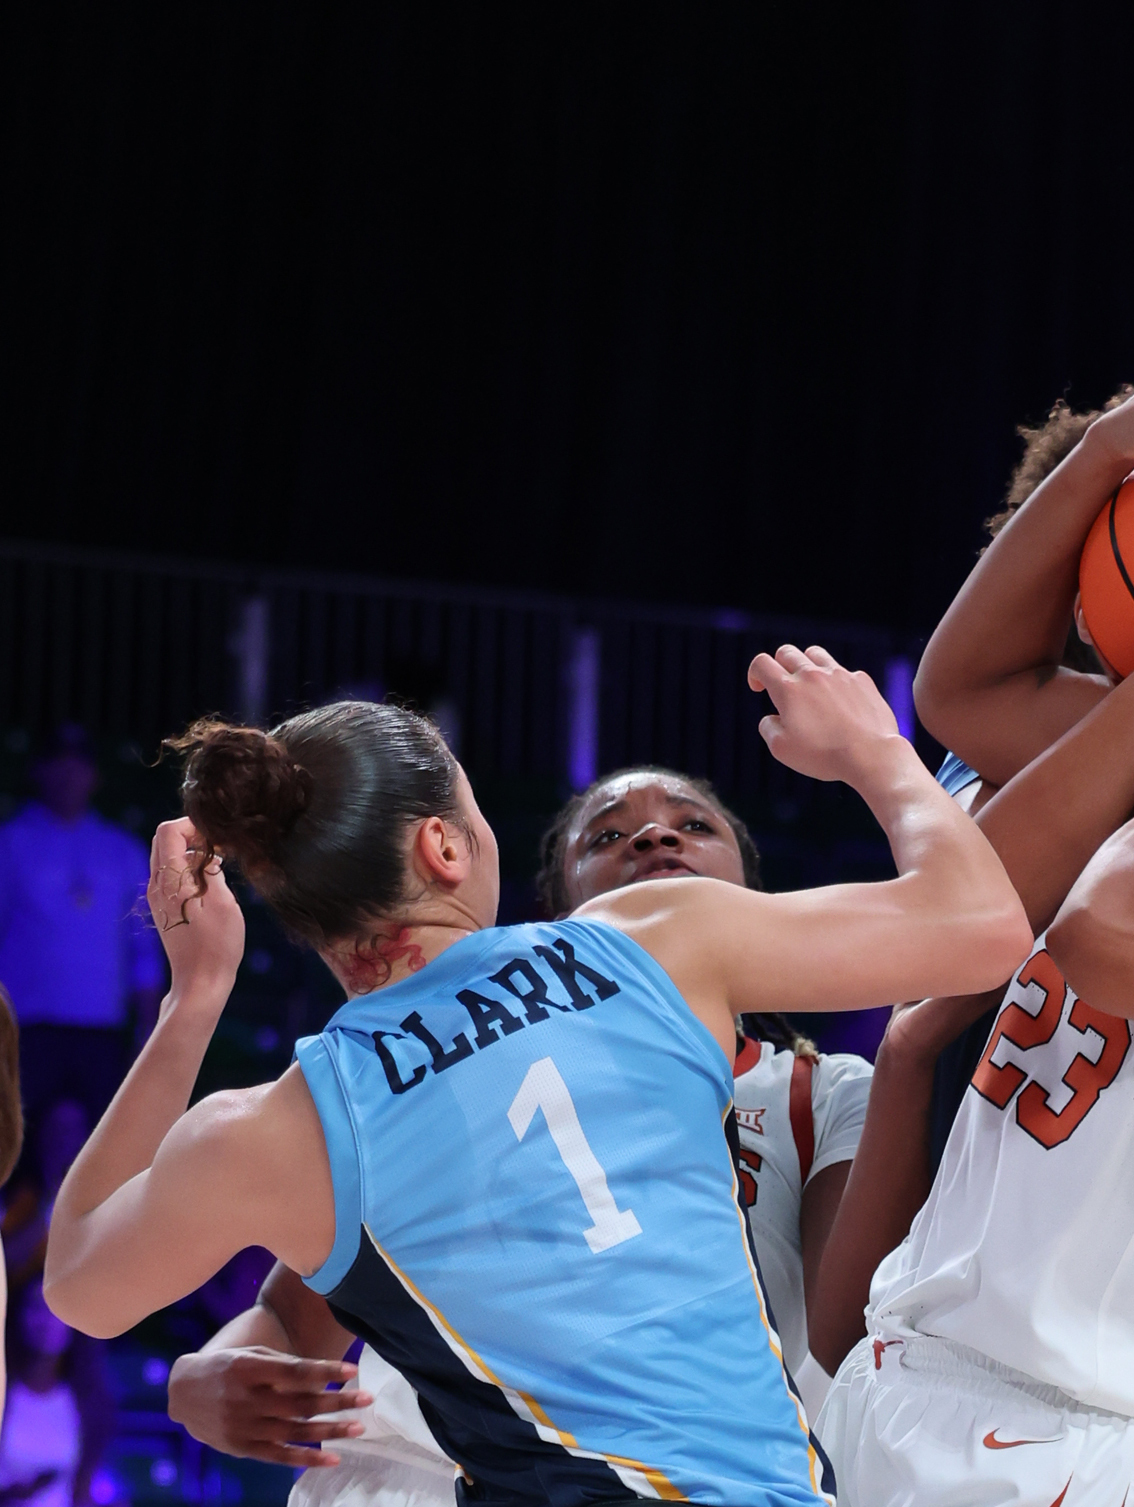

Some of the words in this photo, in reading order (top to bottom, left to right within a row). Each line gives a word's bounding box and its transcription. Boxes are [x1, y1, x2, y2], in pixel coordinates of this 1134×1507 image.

[372, 938, 621, 1095] CLARK
[970, 949, 1132, 1151] 23
[507, 1055, 643, 1255] 1
